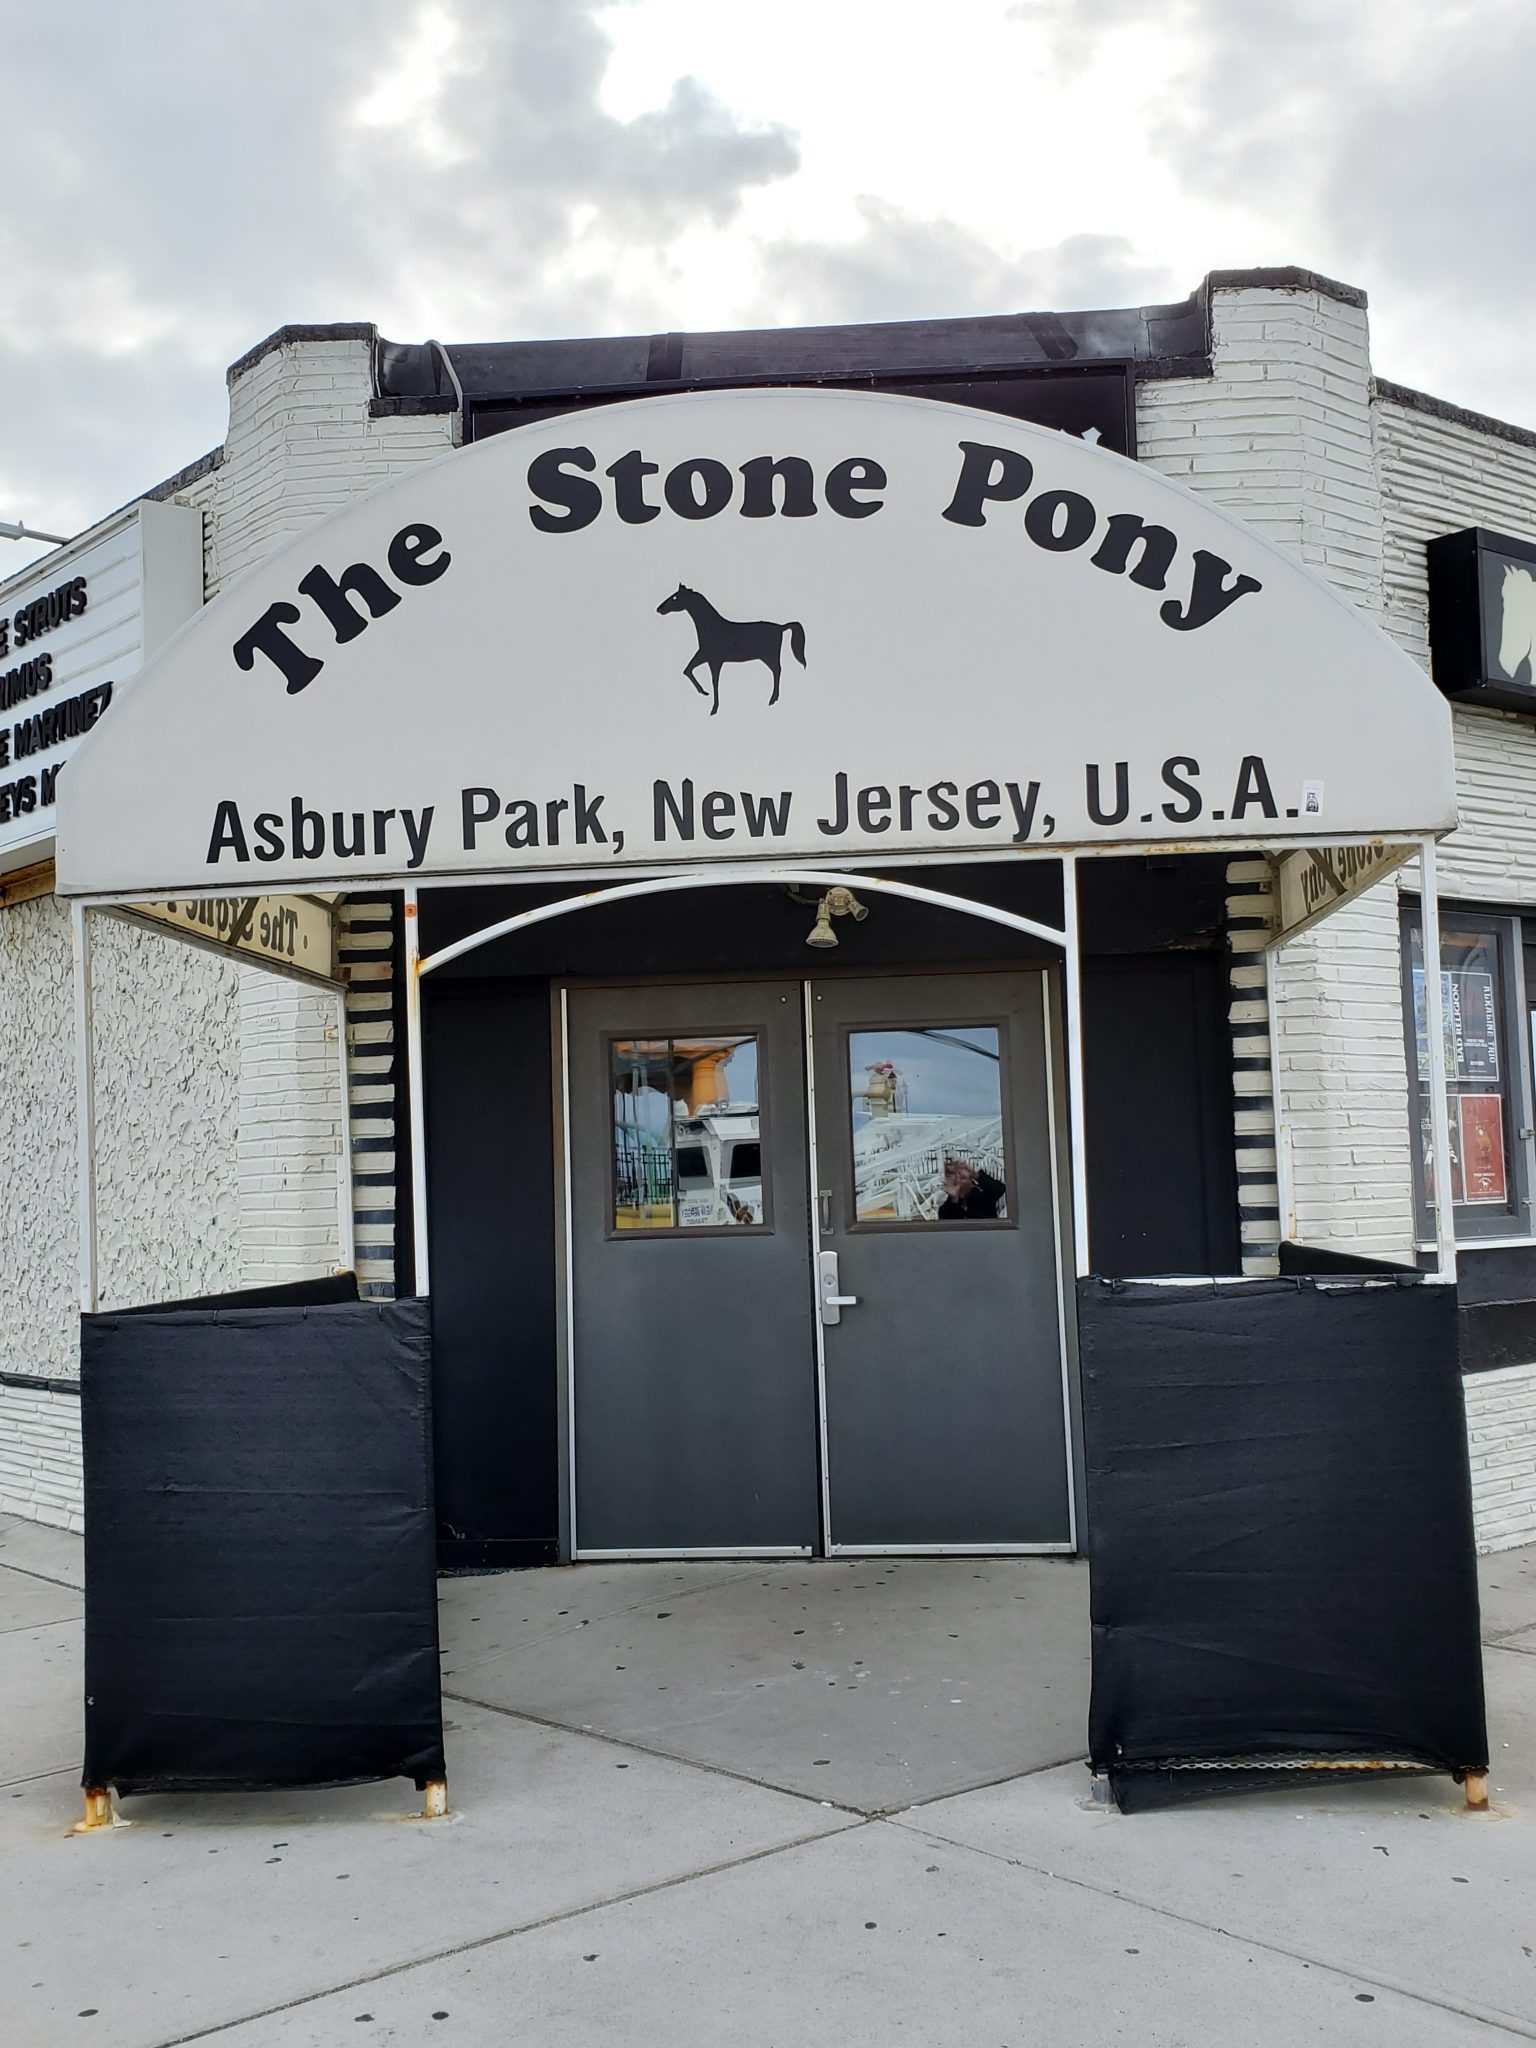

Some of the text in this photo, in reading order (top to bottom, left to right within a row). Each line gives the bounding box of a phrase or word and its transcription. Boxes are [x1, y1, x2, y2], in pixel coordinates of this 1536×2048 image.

[233, 441, 1262, 694] The Stone Pony
[14, 577, 87, 647] STRUTS
[14, 681, 113, 760] MARTINEZ
[41, 761, 67, 806] M
[206, 756, 1298, 868] Asbury Park, New Jersey, U.S.A.
[1452, 983, 1465, 1063] BAD RELIGION
[1483, 986, 1496, 1064] ALKALINE TRIO
